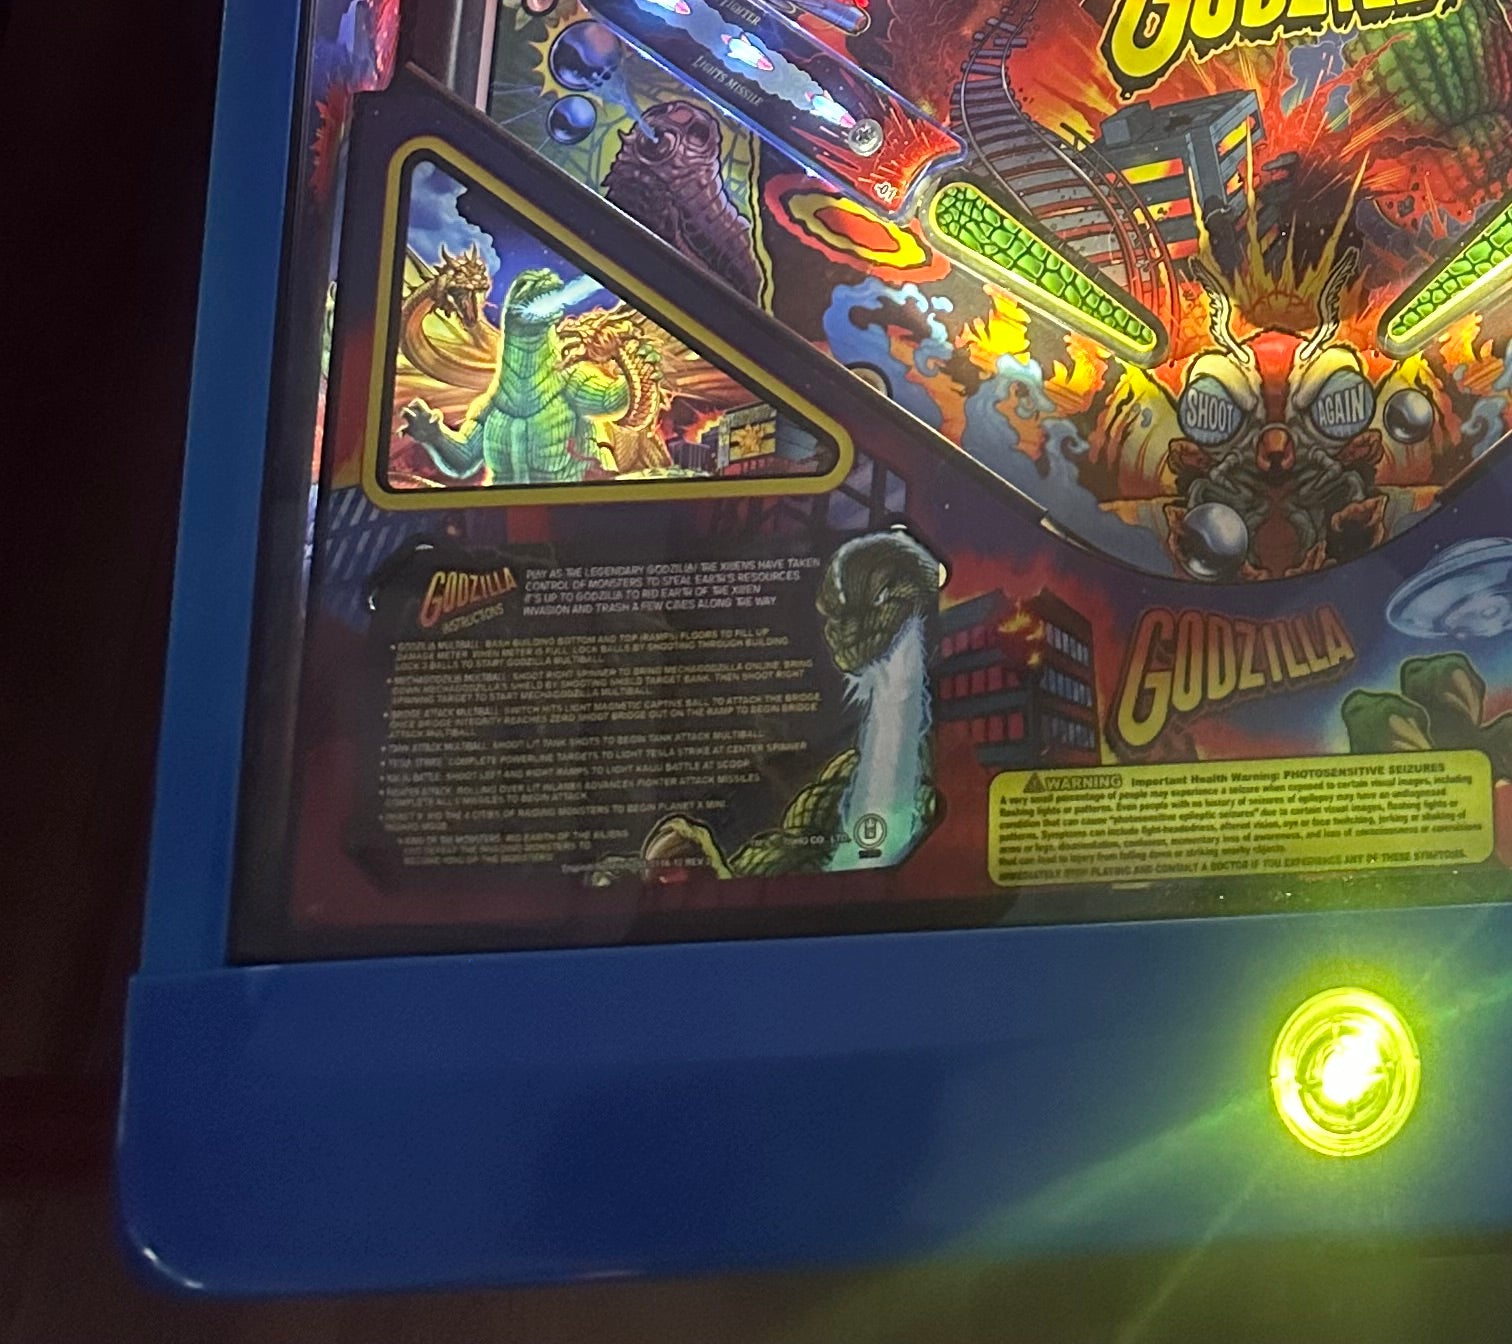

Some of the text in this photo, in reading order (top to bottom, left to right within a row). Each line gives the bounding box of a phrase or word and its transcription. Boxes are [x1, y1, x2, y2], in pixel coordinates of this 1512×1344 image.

[693, 55, 765, 107] LIGHTS MISSILE
[1185, 388, 1369, 436] SHOOT AGAIN
[525, 579, 570, 592] CONTROL
[572, 579, 586, 590] OF
[588, 576, 643, 589] MONSTERS
[646, 576, 660, 587] TO
[662, 574, 689, 587] STEAL
[585, 564, 644, 578] LEGENDARY
[758, 558, 785, 571] HAVE
[787, 557, 820, 569] TAKEN
[419, 566, 519, 628] GODZILLA
[440, 601, 505, 635] INSTRUCTIONS
[1115, 606, 1357, 747] GODZILLA
[1046, 763, 1445, 792] WARNING Important Health Warning: PHOTOSENSITIVE SEIZURES
